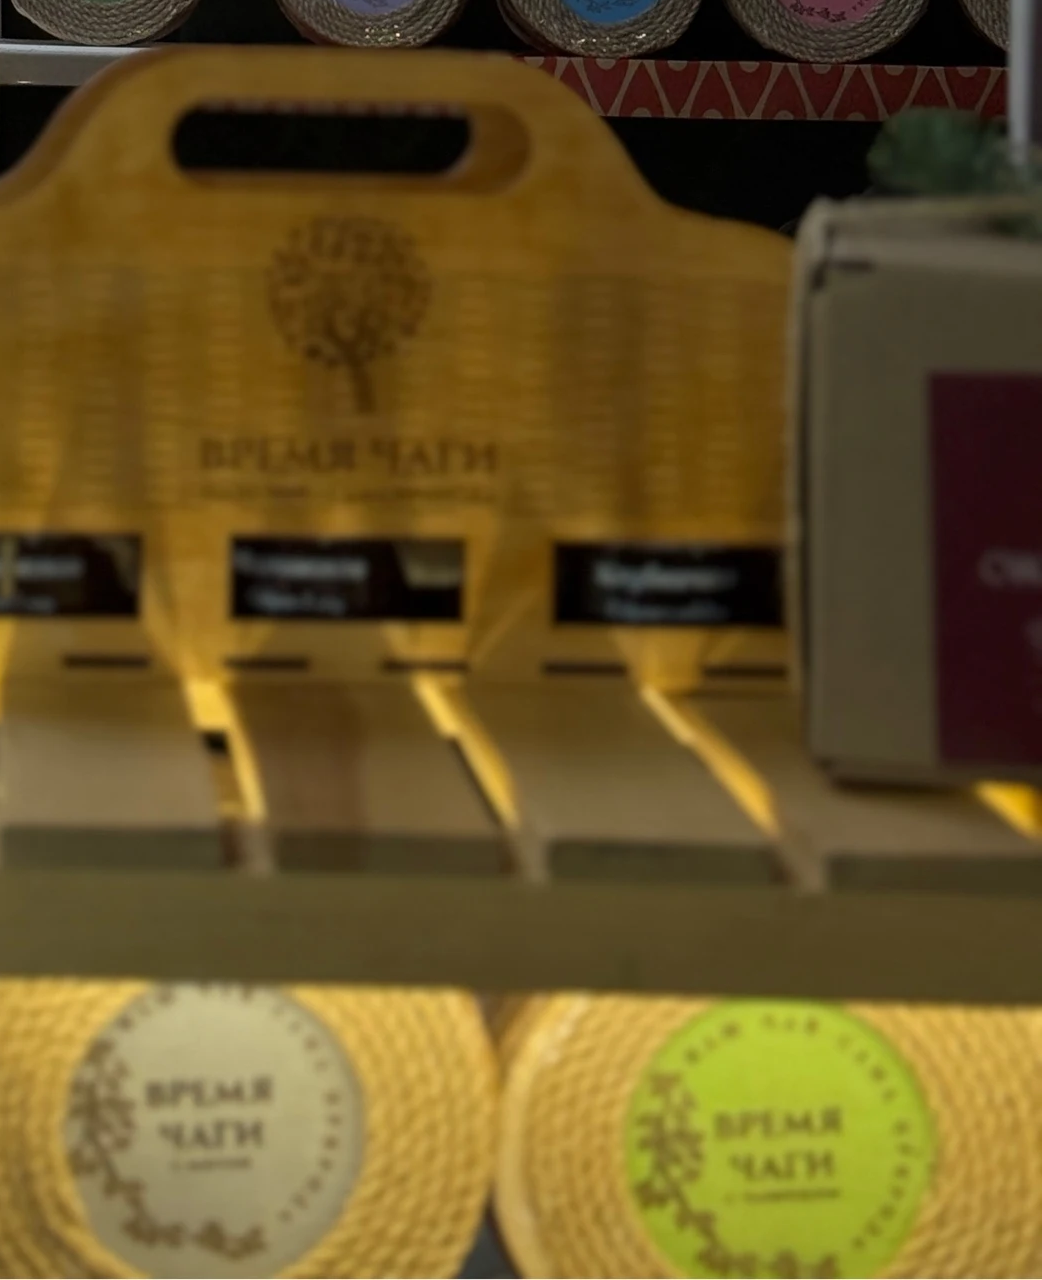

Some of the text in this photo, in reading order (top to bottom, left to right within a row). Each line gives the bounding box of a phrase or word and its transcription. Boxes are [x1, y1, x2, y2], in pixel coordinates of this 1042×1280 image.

[145, 1075, 274, 1109] ВРЕМЯ
[159, 1120, 264, 1149] ЧАГИ
[713, 1107, 843, 1140] ВРЕМЯ
[728, 1150, 835, 1181] ЧАГИ
